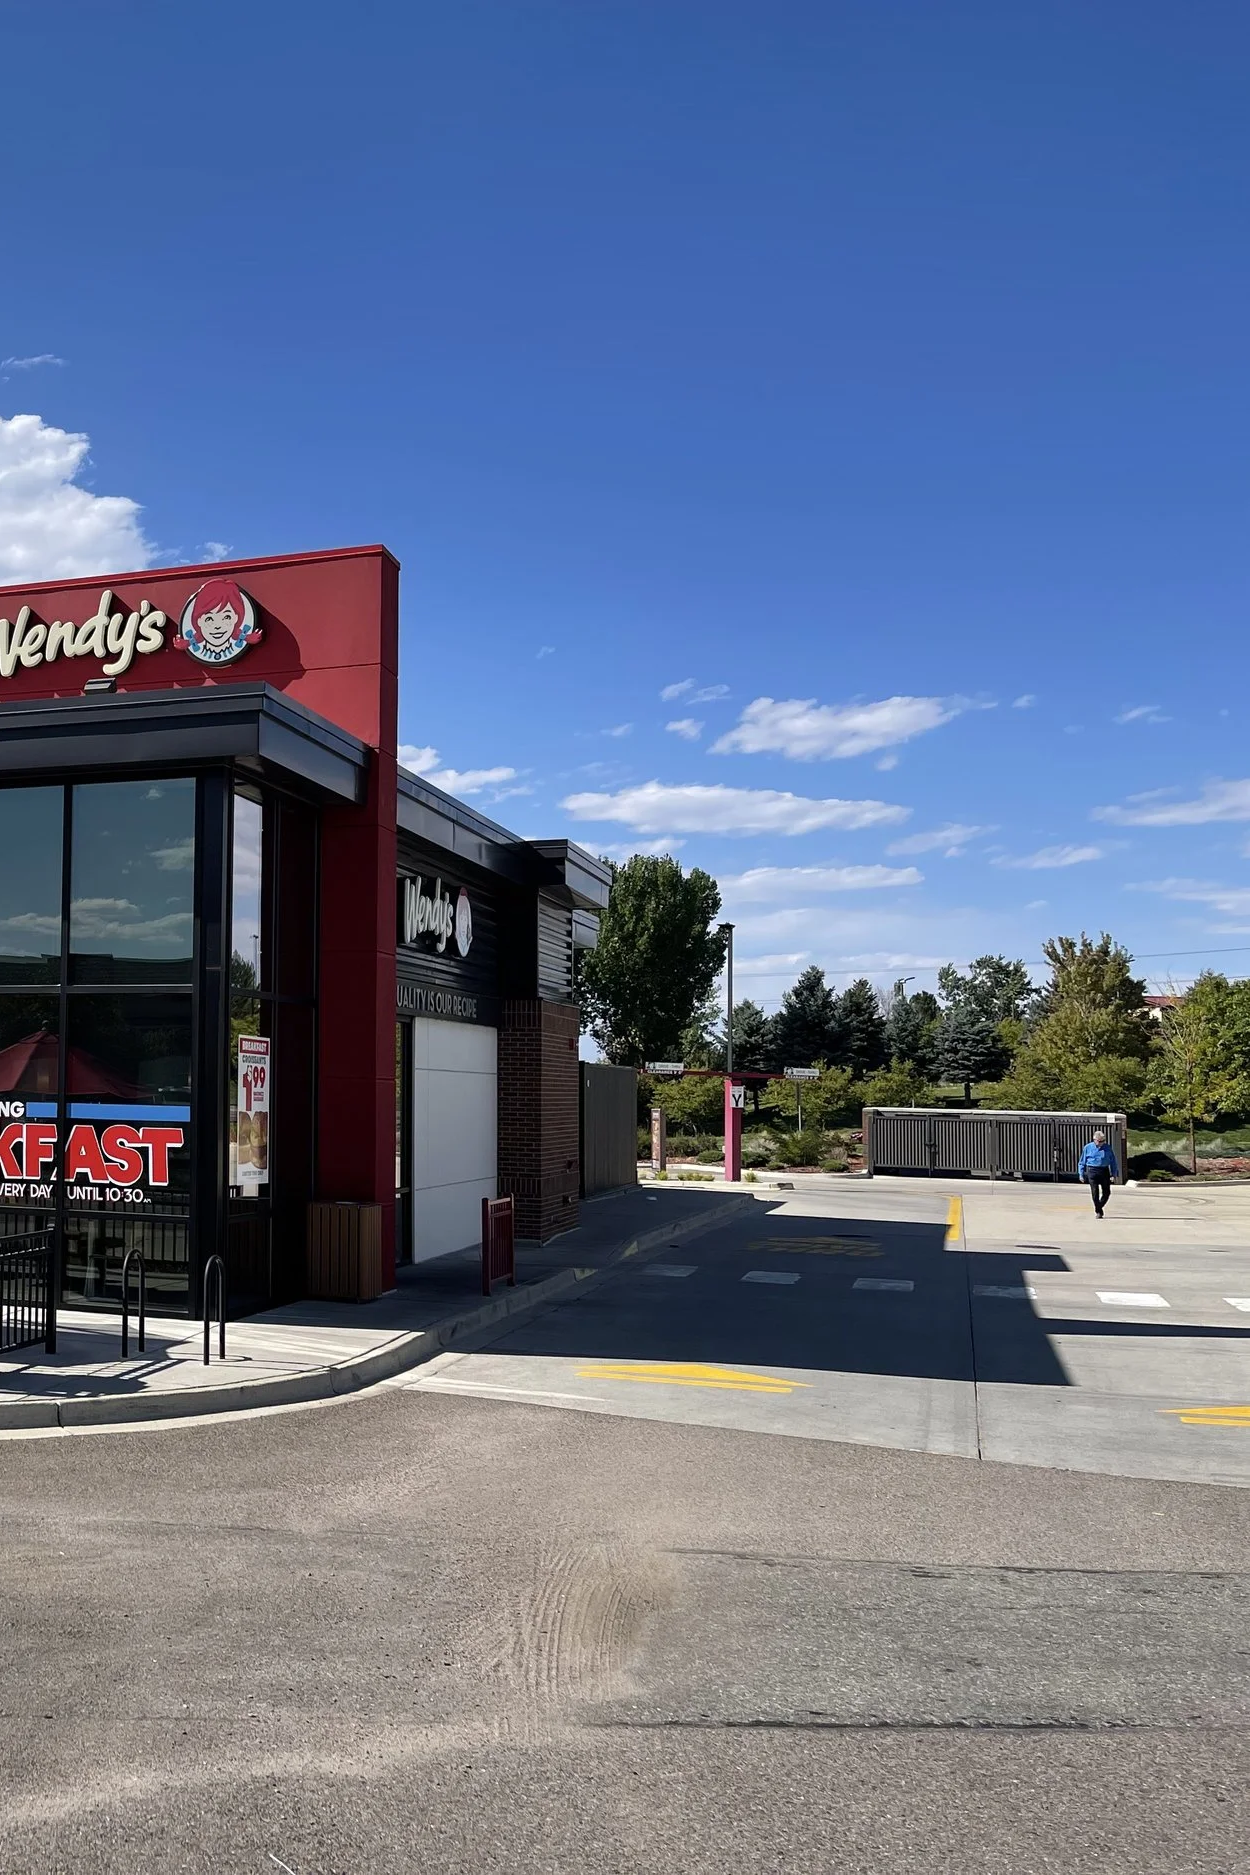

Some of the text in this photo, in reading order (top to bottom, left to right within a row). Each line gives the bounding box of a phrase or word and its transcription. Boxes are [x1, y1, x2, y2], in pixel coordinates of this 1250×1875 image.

[404, 875, 454, 953] Wendy's
[396, 984, 427, 1011] UALITY
[435, 991, 452, 1014] OUR
[452, 995, 477, 1018] RECIPE
[29, 1185, 54, 1198] DAY
[67, 1186, 103, 1200] UNTIL
